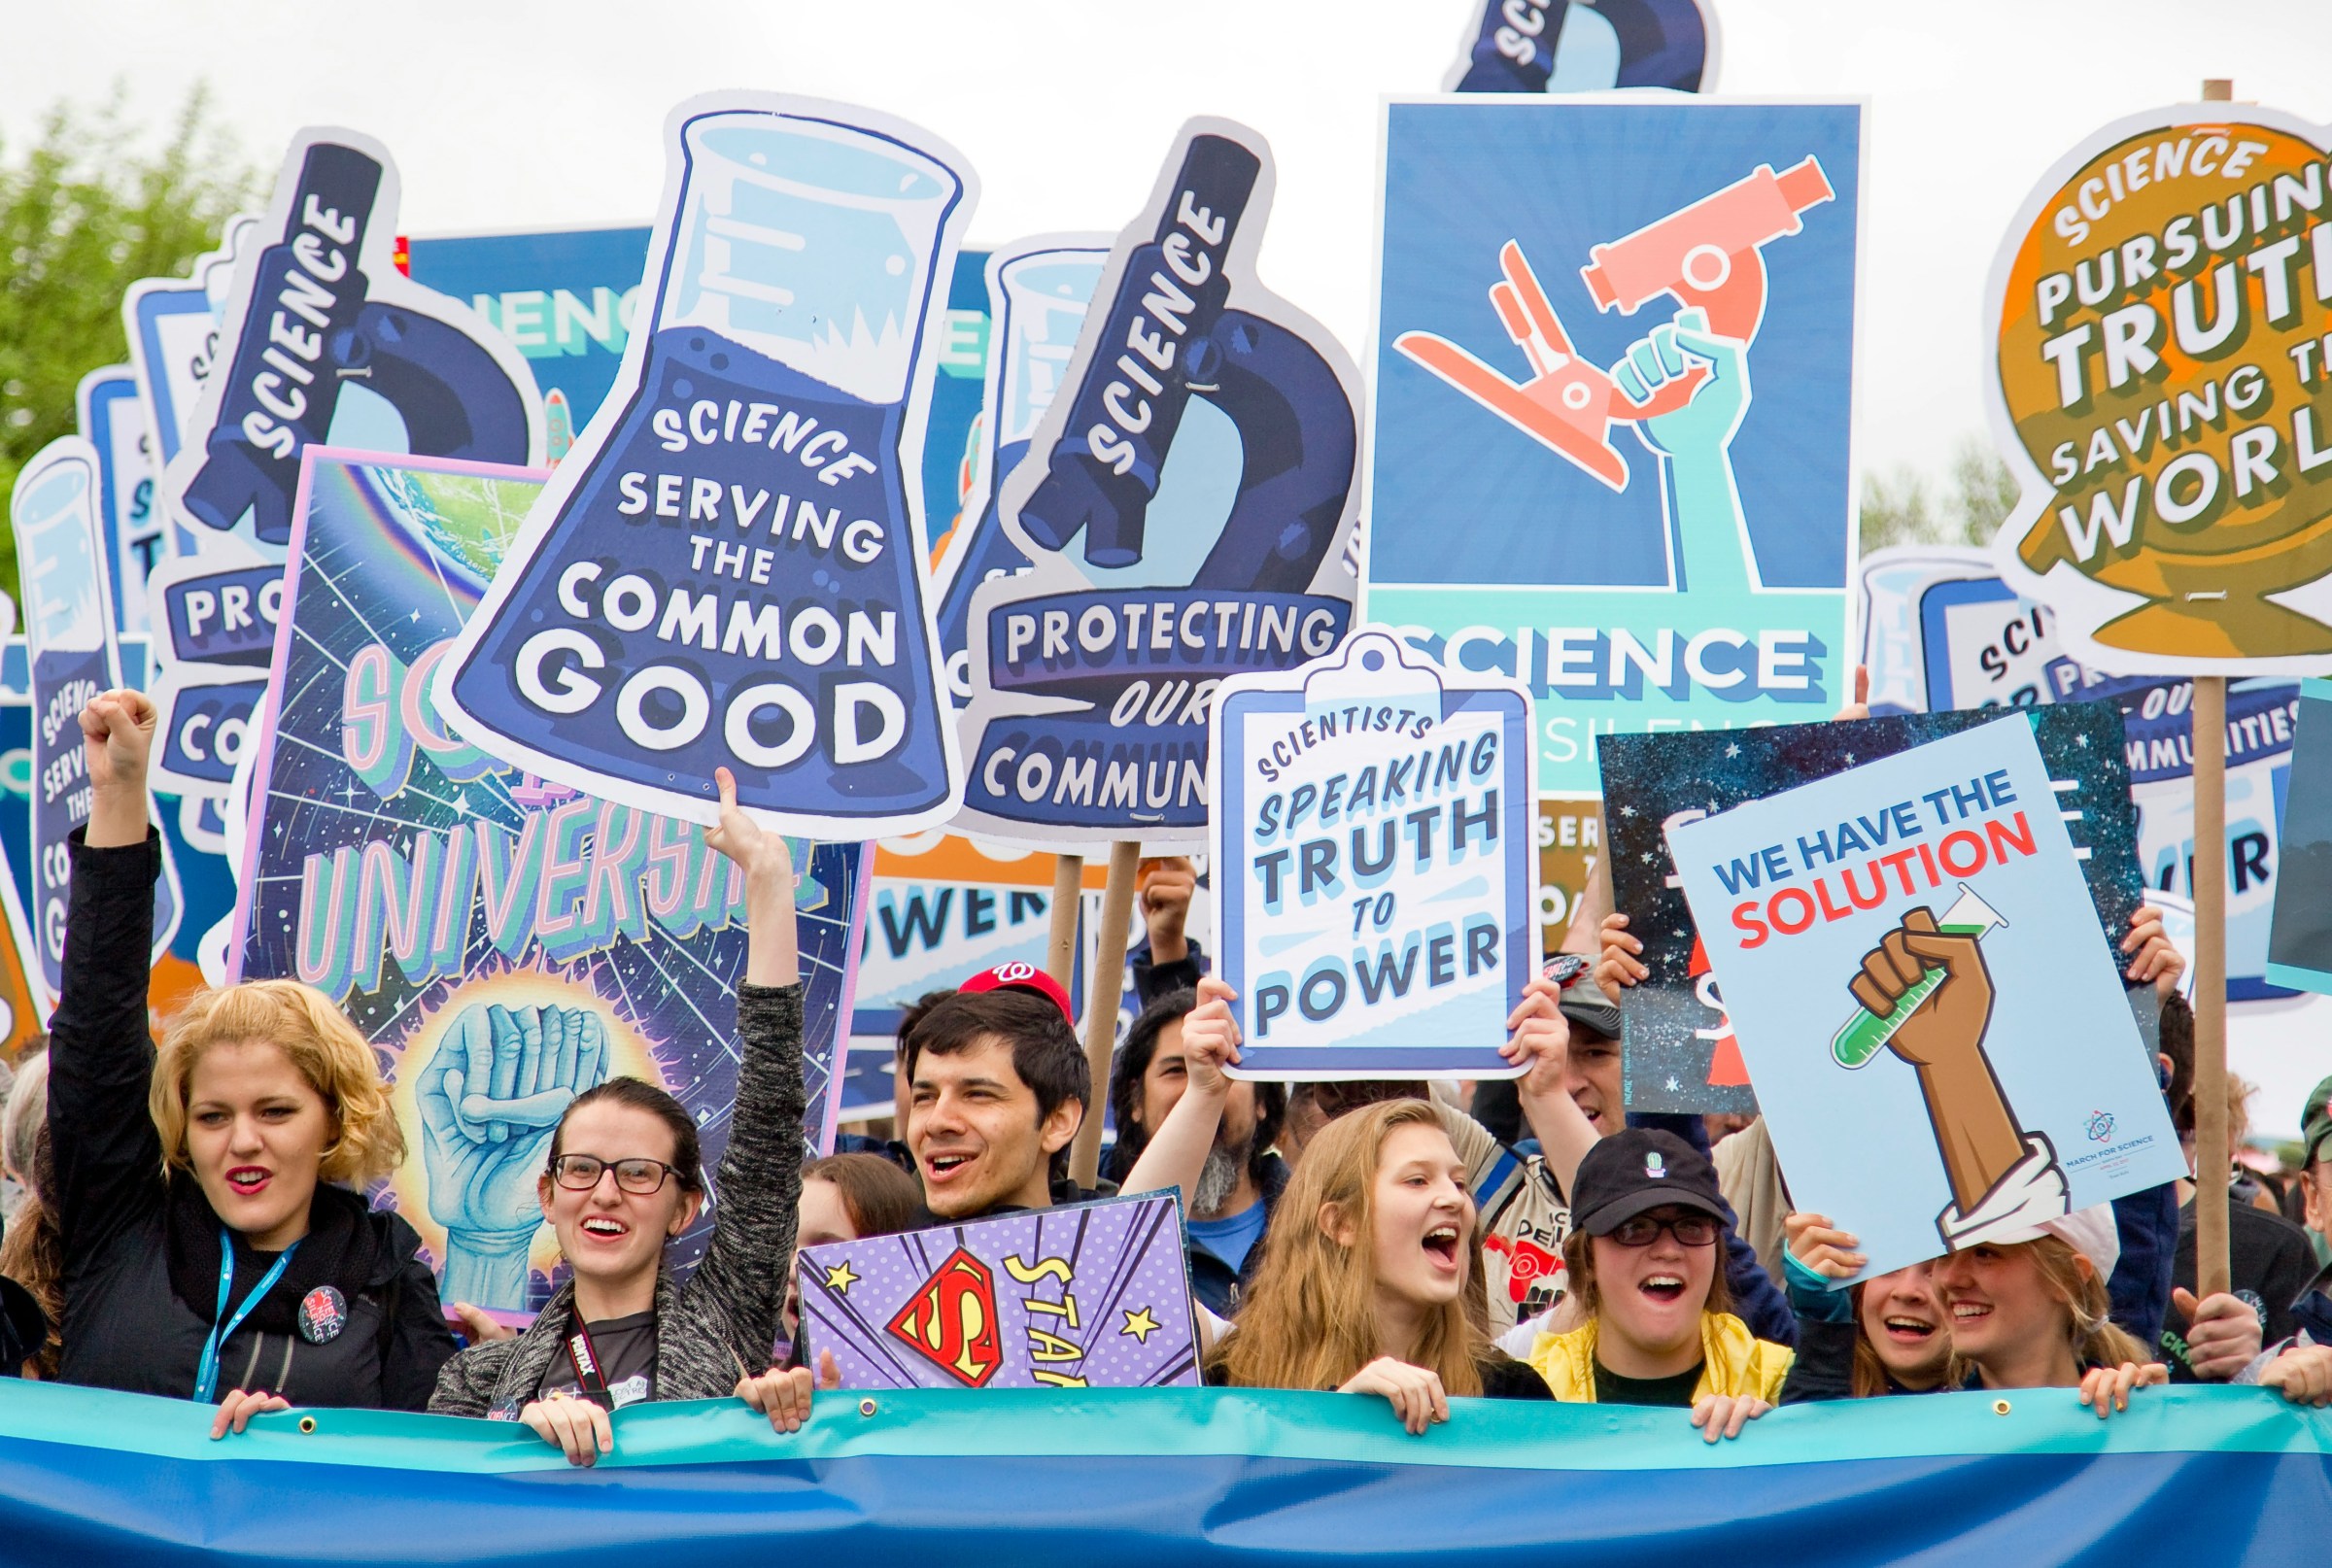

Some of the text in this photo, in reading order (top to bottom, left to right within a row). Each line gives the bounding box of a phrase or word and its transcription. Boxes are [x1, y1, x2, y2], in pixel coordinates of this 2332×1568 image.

[2053, 134, 2269, 247] SCIENCE
[2036, 159, 2332, 326] PURSUIN
[241, 193, 355, 460] SCIENCE
[1086, 190, 1226, 476] SCIENCE
[652, 399, 877, 488] SCIENCE
[2051, 364, 2266, 486] SAVING
[618, 471, 885, 564] SERVING
[690, 535, 775, 585] THE
[557, 560, 897, 667] COMMON
[1007, 600, 1337, 665] PROTECTING
[1395, 624, 1811, 690] SCIENCE
[515, 628, 907, 768] GOOD
[1110, 679, 1213, 727] OUR
[1258, 705, 1433, 783] SCIENTISTS
[1254, 731, 1499, 837] SPEAKING
[1254, 789, 1499, 904] TRUTH
[1712, 850, 1789, 896] WE
[1795, 801, 1922, 871] HAVE
[1922, 768, 2018, 825] THE
[1353, 891, 1396, 933] TO
[1731, 810, 2039, 950] SOLUTION
[1255, 923, 1500, 1038] POWER
[2067, 1154, 2097, 1167] MARCH
[2099, 1147, 2116, 1157] FOR
[2117, 1135, 2154, 1151] SCIENCE
[306, 1298, 324, 1343] SILENCE
[317, 1306, 327, 1327] NOT
[320, 1289, 339, 1339] SCIENCE
[569, 1334, 596, 1377] PENTAX
